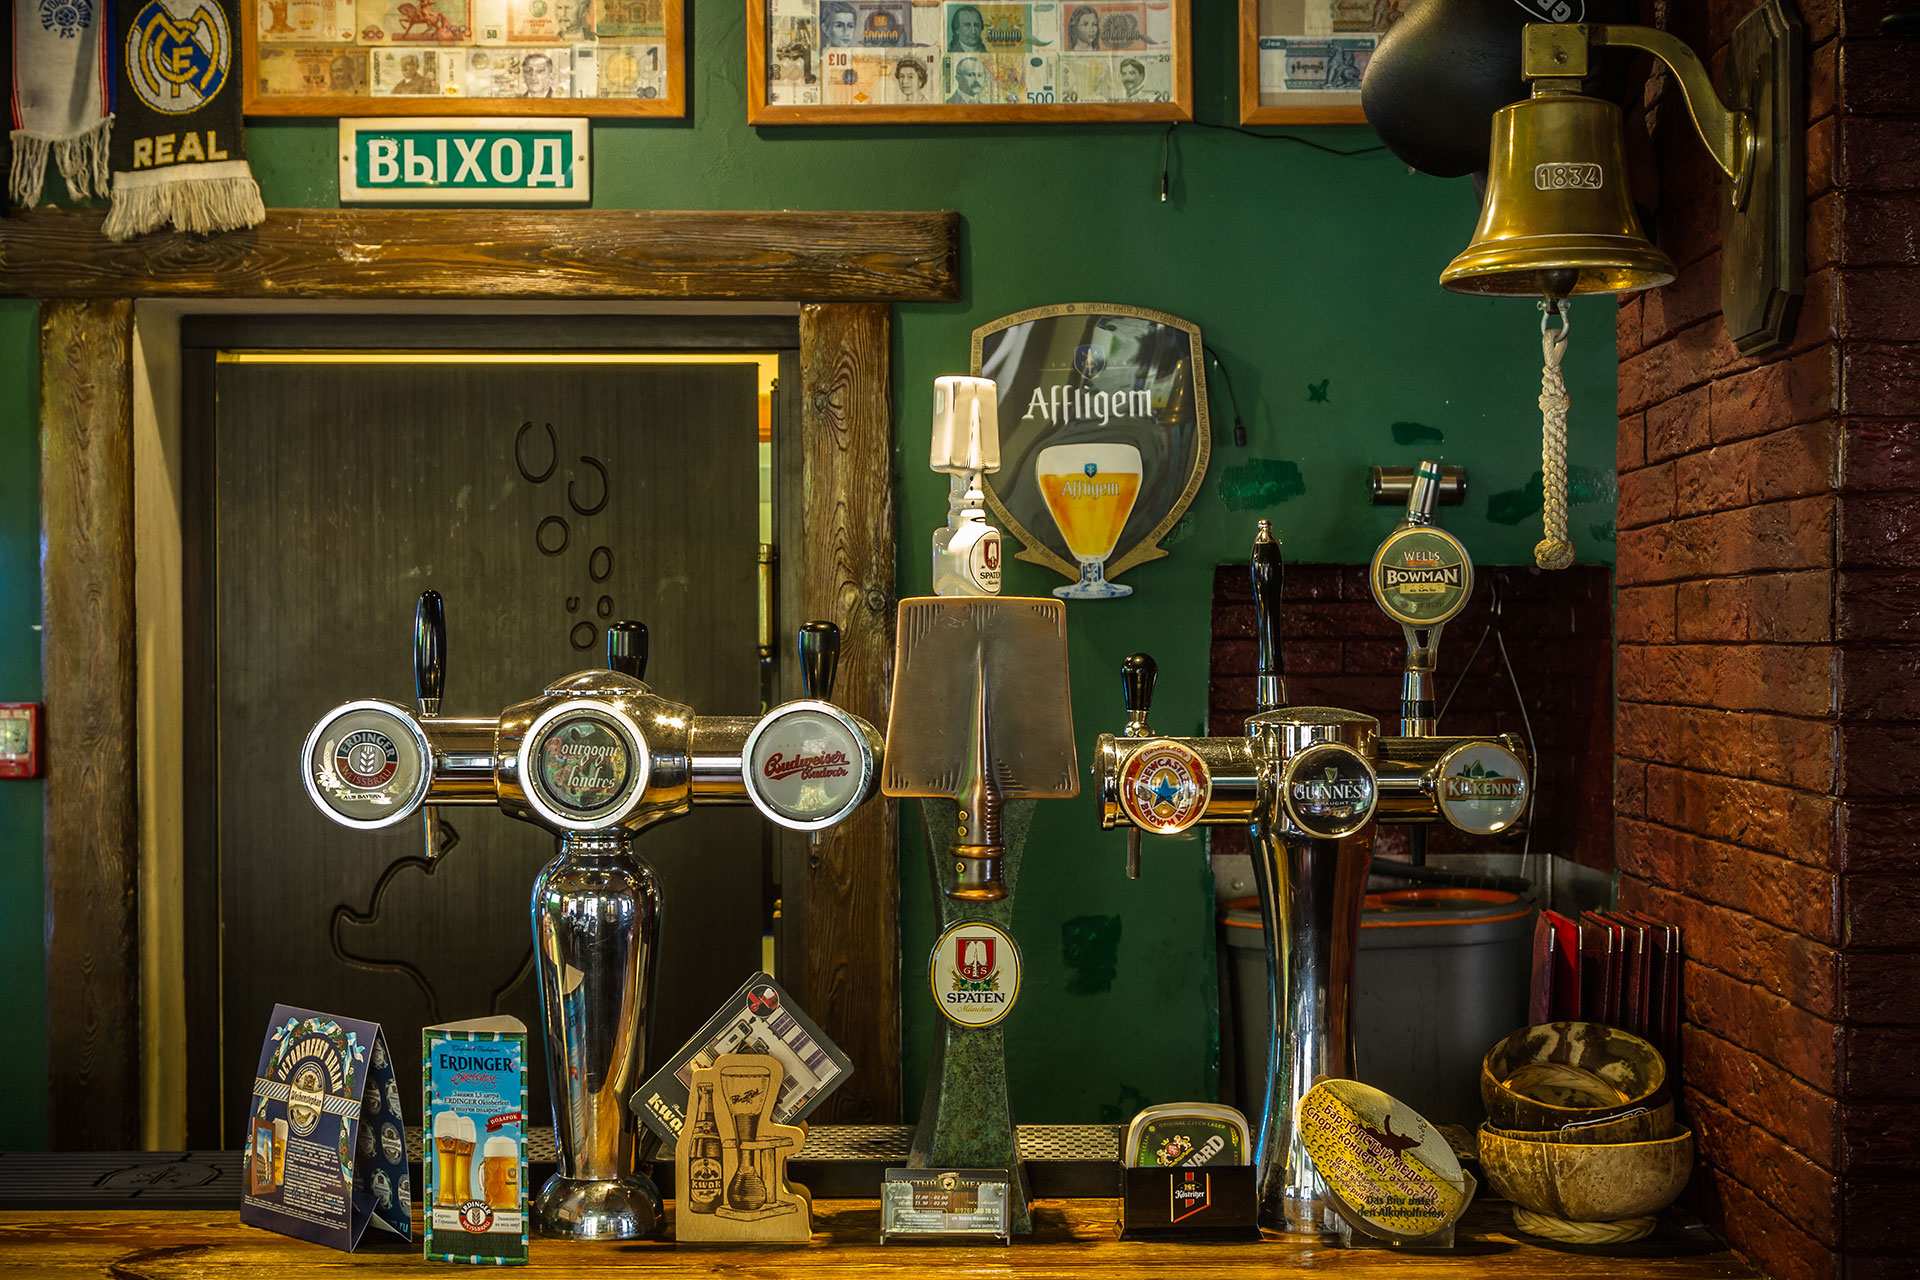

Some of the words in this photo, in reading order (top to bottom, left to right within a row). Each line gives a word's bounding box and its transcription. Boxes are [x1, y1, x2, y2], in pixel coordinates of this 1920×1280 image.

[828, 53, 847, 66] £10
[1026, 91, 1054, 103] 500
[133, 130, 229, 168] REAL
[366, 136, 568, 187] ВЫХОД
[1539, 167, 1601, 189] 1834
[1021, 384, 1153, 426] Affligem
[1061, 480, 1121, 498] Affligem
[1403, 551, 1441, 561] WELLS
[1386, 568, 1459, 585] BOWMAN
[341, 732, 396, 758] ERDINGER
[764, 750, 850, 778] Budweiser
[800, 766, 849, 780] Budvar
[1140, 801, 1177, 827] BROWN
[946, 992, 1006, 1004] SPATEN
[439, 1053, 514, 1073] ERDINGER
[1323, 1104, 1345, 1125] Бар
[1345, 1120, 1393, 1162] ТОЛСТЫЙ
[461, 1200, 492, 1216] ERDINGER
